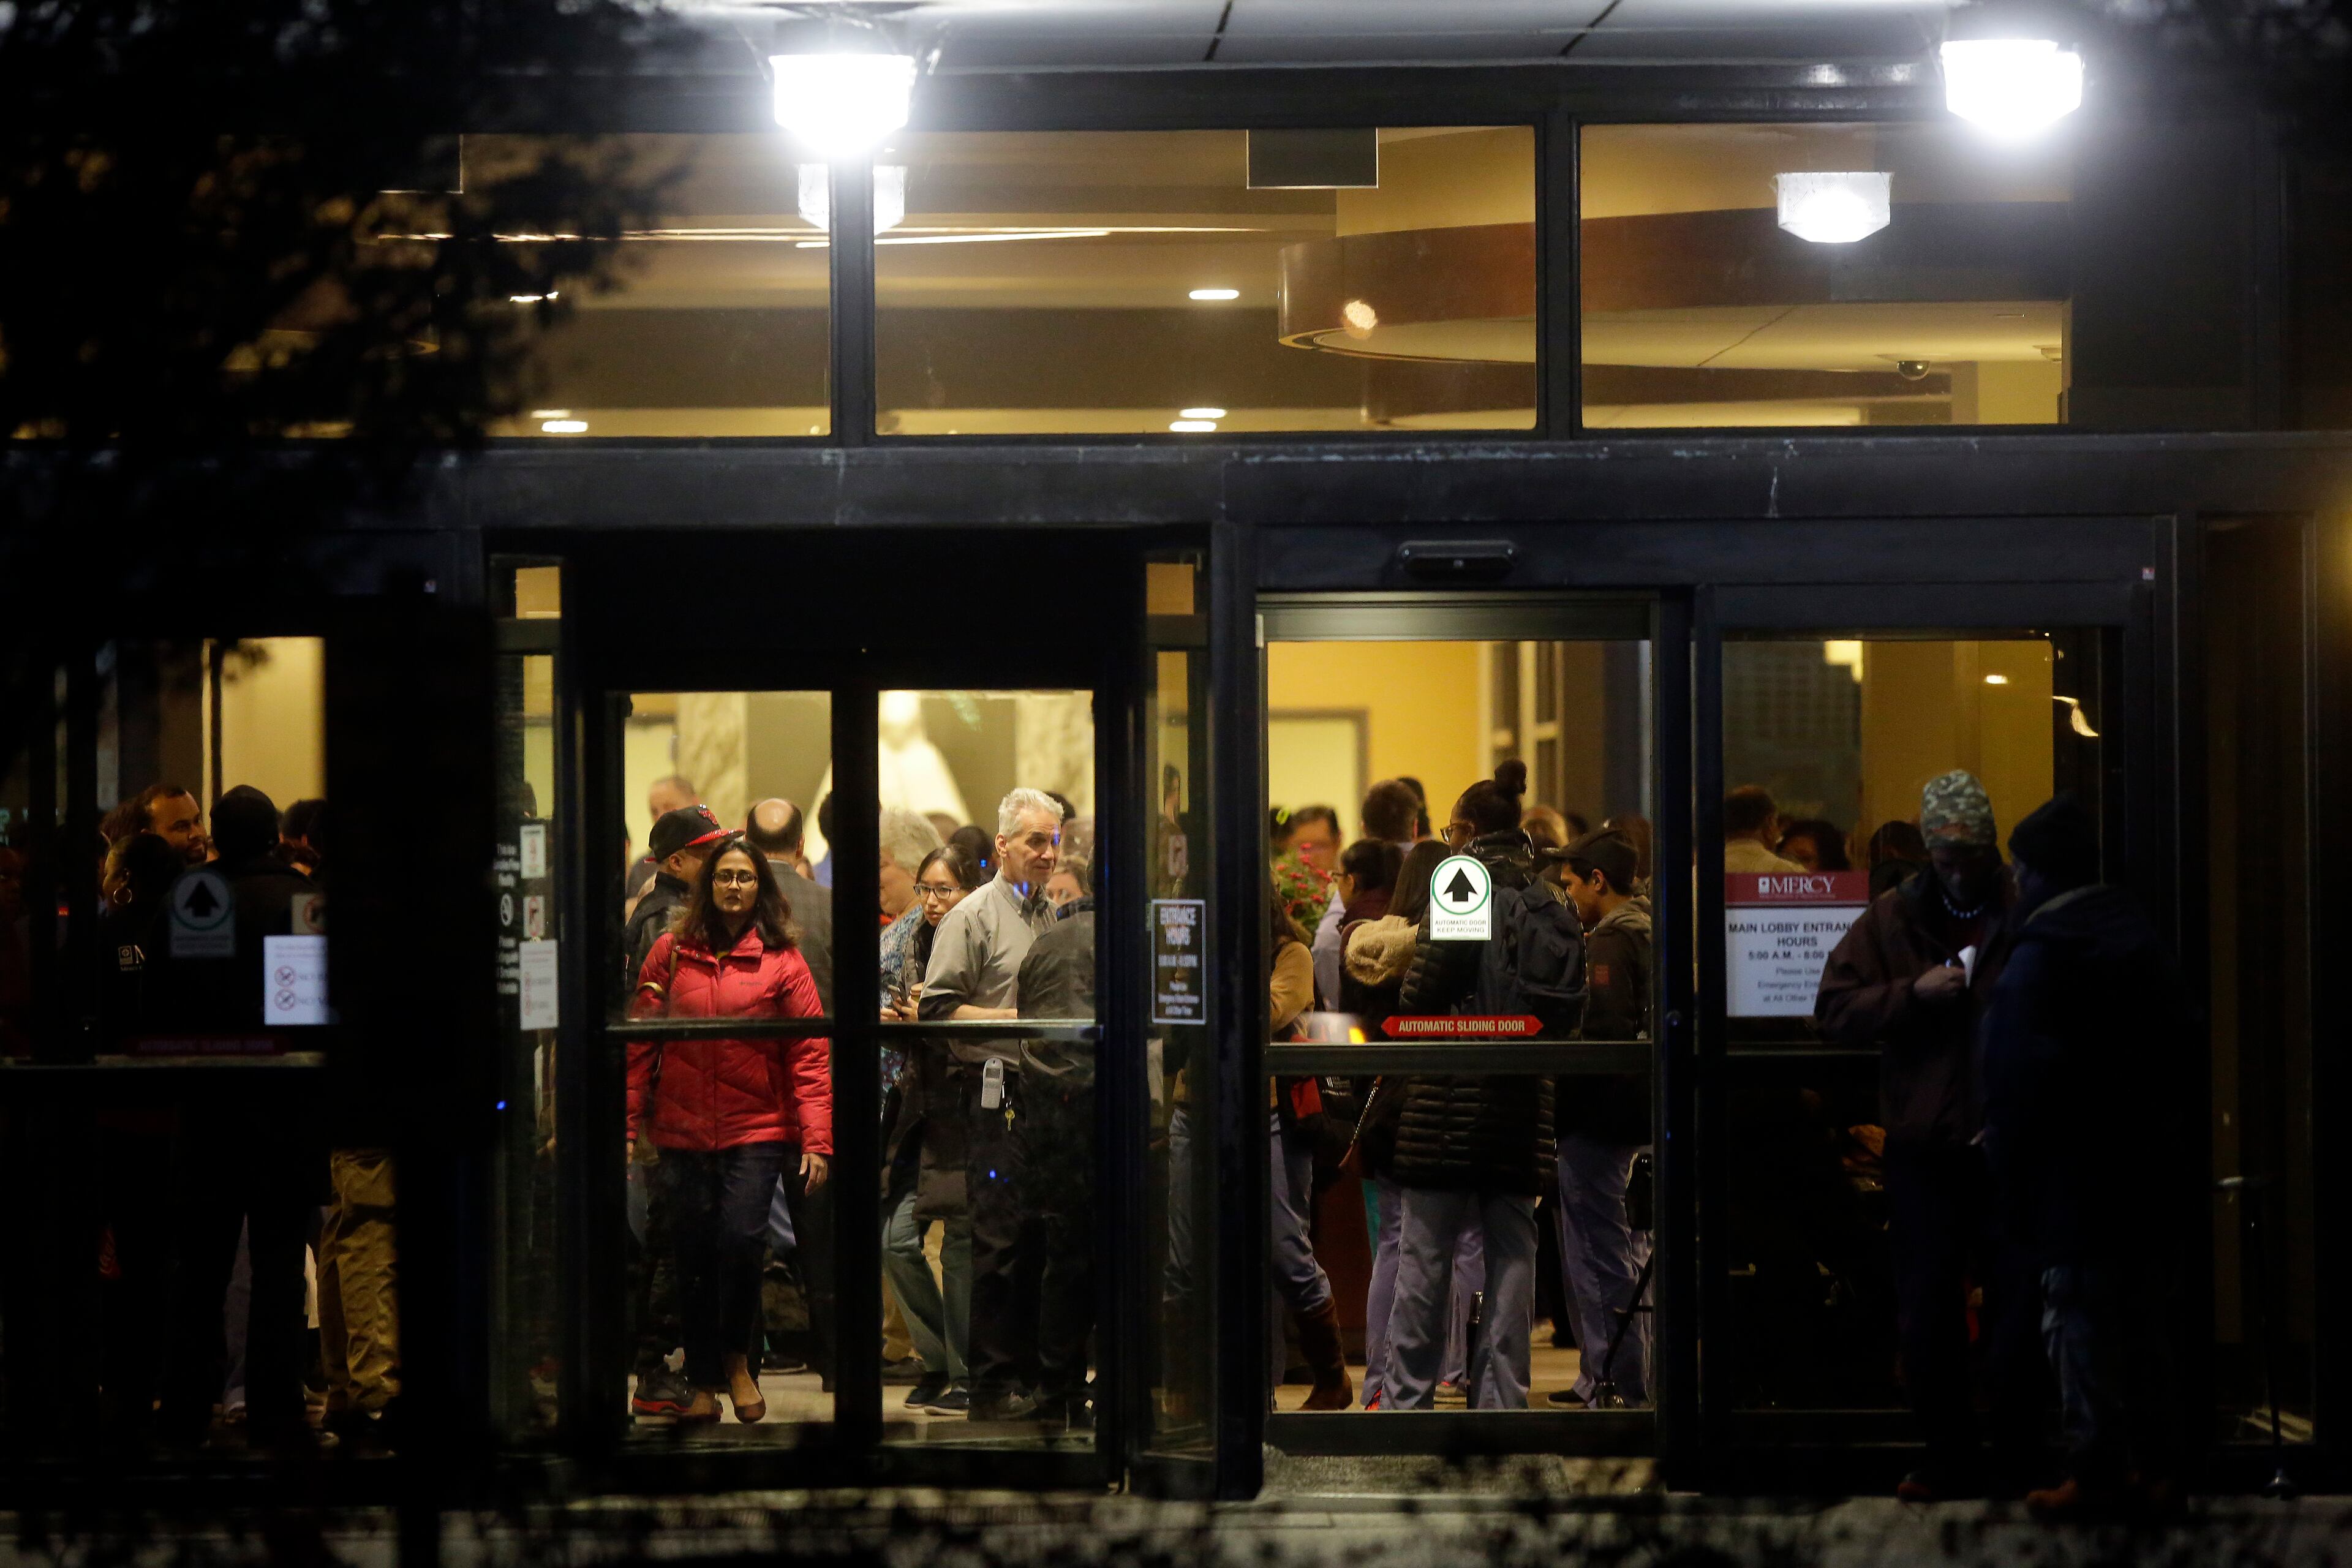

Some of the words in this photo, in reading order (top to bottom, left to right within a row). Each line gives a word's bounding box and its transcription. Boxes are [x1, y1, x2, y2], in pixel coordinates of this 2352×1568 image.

[1771, 876, 1834, 894] MERCY
[1728, 922, 1757, 932] MAIN
[1761, 922, 1798, 932] LOBBY
[1777, 937, 1817, 947] HOURS
[1757, 981, 1802, 990] Emergency
[1398, 1020, 1454, 1032] AUTOMATIC
[1457, 1020, 1495, 1032] SLIDING
[1498, 1020, 1525, 1032] DOOR
